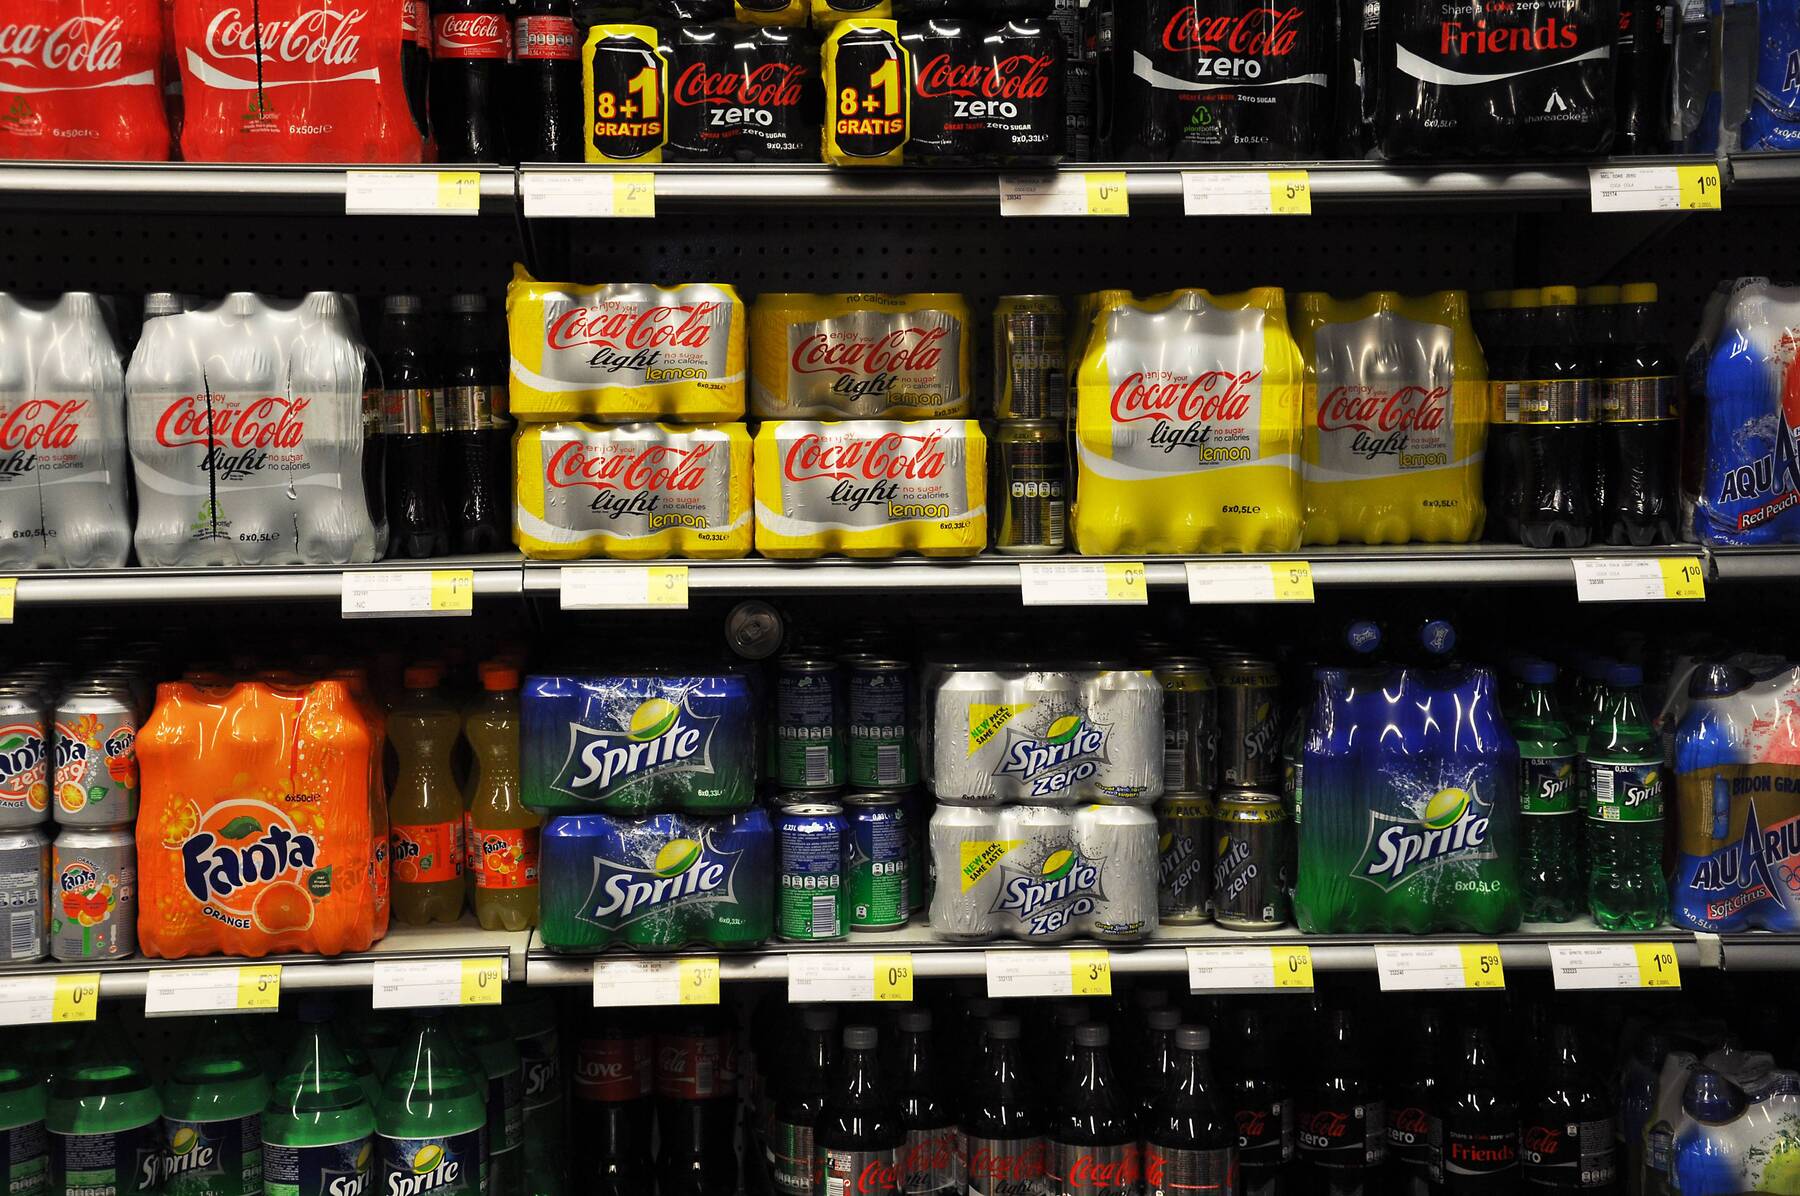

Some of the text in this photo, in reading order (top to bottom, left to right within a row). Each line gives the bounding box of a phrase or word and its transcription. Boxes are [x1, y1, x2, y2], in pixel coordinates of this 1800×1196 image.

[1441, 4, 1473, 15] Share
[205, 7, 368, 65] Coca-Cola
[443, 15, 500, 38] Coca-Cola
[1162, 6, 1304, 56] Coca-Cola
[1440, 17, 1579, 55] Friends
[0, 15, 123, 72] ca-Cola
[917, 54, 1054, 99] Coca-Cola
[1197, 57, 1262, 78] zero
[673, 61, 807, 106] Coca-Cola
[953, 99, 1018, 118] zero
[1237, 94, 1256, 103] zero
[710, 107, 773, 126] zero
[836, 119, 903, 136] GRATIS
[987, 121, 1010, 130] zero
[594, 122, 662, 137] GRATIS
[742, 127, 765, 137] zero
[846, 294, 860, 304] no
[547, 301, 722, 350] Coca-Cola
[585, 347, 663, 373] light
[791, 326, 950, 375] Coca-Cola
[645, 367, 707, 381] lemon
[1144, 370, 1173, 382] enjoy
[831, 373, 898, 401] light
[887, 390, 943, 406] lemon
[1110, 370, 1263, 423] Coca-Cola
[1317, 385, 1452, 432] Coca-Cola
[155, 395, 312, 449] Coca-Cola
[1224, 427, 1245, 437] sugar
[1147, 420, 1213, 454] light
[1224, 434, 1250, 443] calories
[1351, 431, 1409, 460] light
[784, 425, 952, 482] Coca-Cola
[1199, 444, 1251, 461] lemon
[1399, 451, 1447, 467] lemon
[546, 440, 716, 491] Coca-Cola
[588, 489, 661, 520] light
[826, 479, 900, 512] light
[917, 492, 950, 500] calories
[1766, 493, 1799, 517] Peach
[887, 500, 949, 518] lemon
[1222, 505, 1252, 514] 6x0,5L
[1742, 508, 1765, 528] Red
[648, 512, 707, 530] lemon
[239, 532, 272, 542] 6x0,5L
[970, 718, 991, 740] NEW
[975, 712, 1013, 746] SAME TASTE
[571, 716, 700, 790] Sprite
[1001, 720, 1104, 780] Sprite
[1031, 761, 1097, 797] zero
[1733, 776, 1772, 797] BIDON
[284, 793, 315, 803] 6x50cl
[482, 841, 507, 856] Fanta
[1368, 804, 1489, 879] Sprite
[182, 824, 315, 902] Fanta
[963, 855, 984, 877] NEW
[969, 847, 1006, 882] SAME TASTE
[61, 868, 96, 893] Fanta
[596, 857, 724, 918] Sprite
[1000, 856, 1097, 918] Sprite
[1170, 858, 1201, 898] zero
[1226, 862, 1259, 901] zero
[1455, 880, 1491, 893] 6x0,5L
[1734, 887, 1767, 909] Citrus
[203, 906, 251, 929] ORANGE
[1029, 897, 1095, 936] zero
[1710, 900, 1734, 920] Soft
[577, 1054, 623, 1078] Love
[1451, 1142, 1515, 1164] Friends
